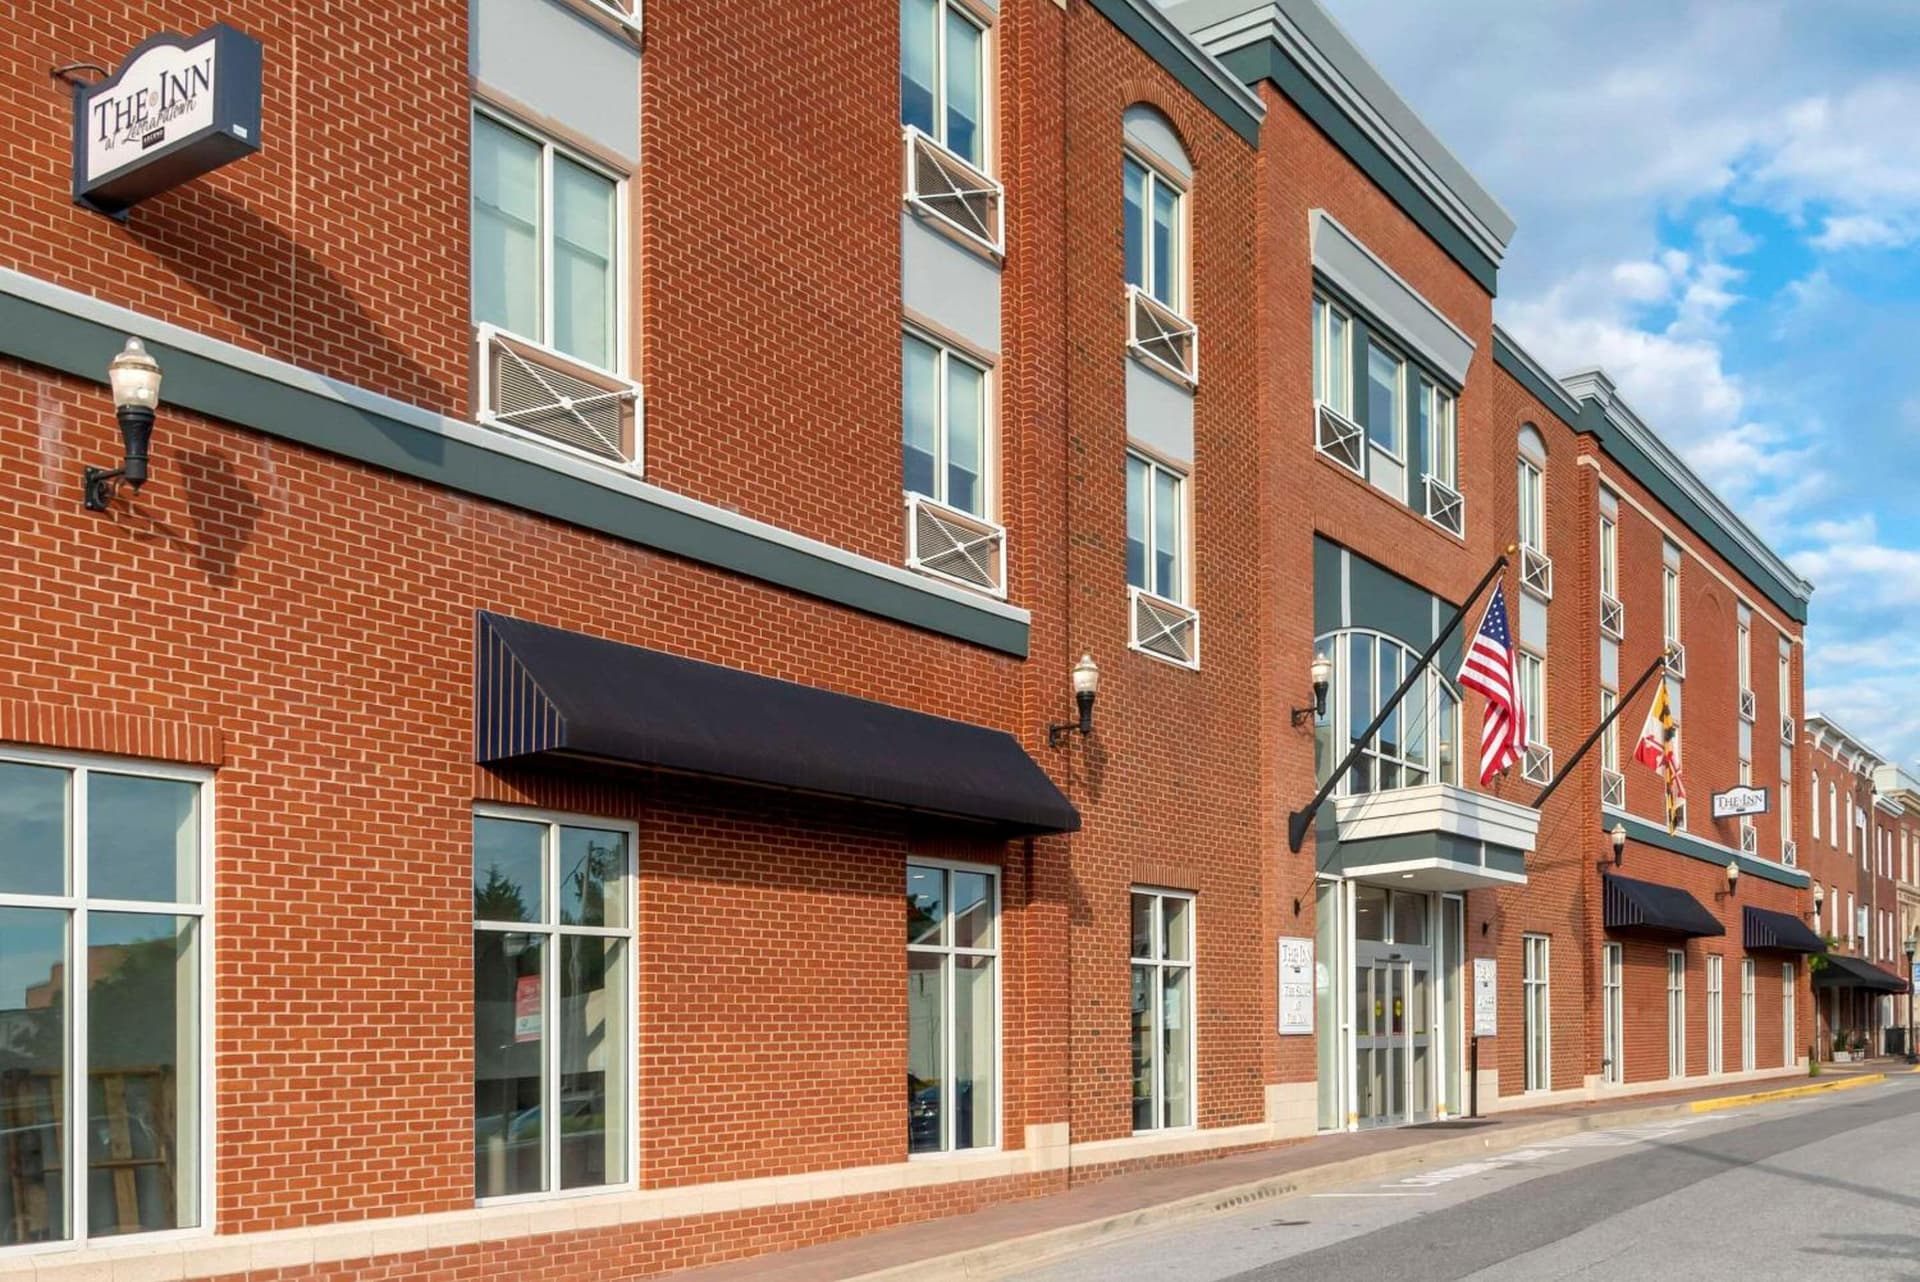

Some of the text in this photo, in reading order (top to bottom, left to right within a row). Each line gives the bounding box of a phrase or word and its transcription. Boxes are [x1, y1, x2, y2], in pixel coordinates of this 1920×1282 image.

[94, 57, 211, 142] THE INN
[1715, 793, 1763, 808] THE INN
